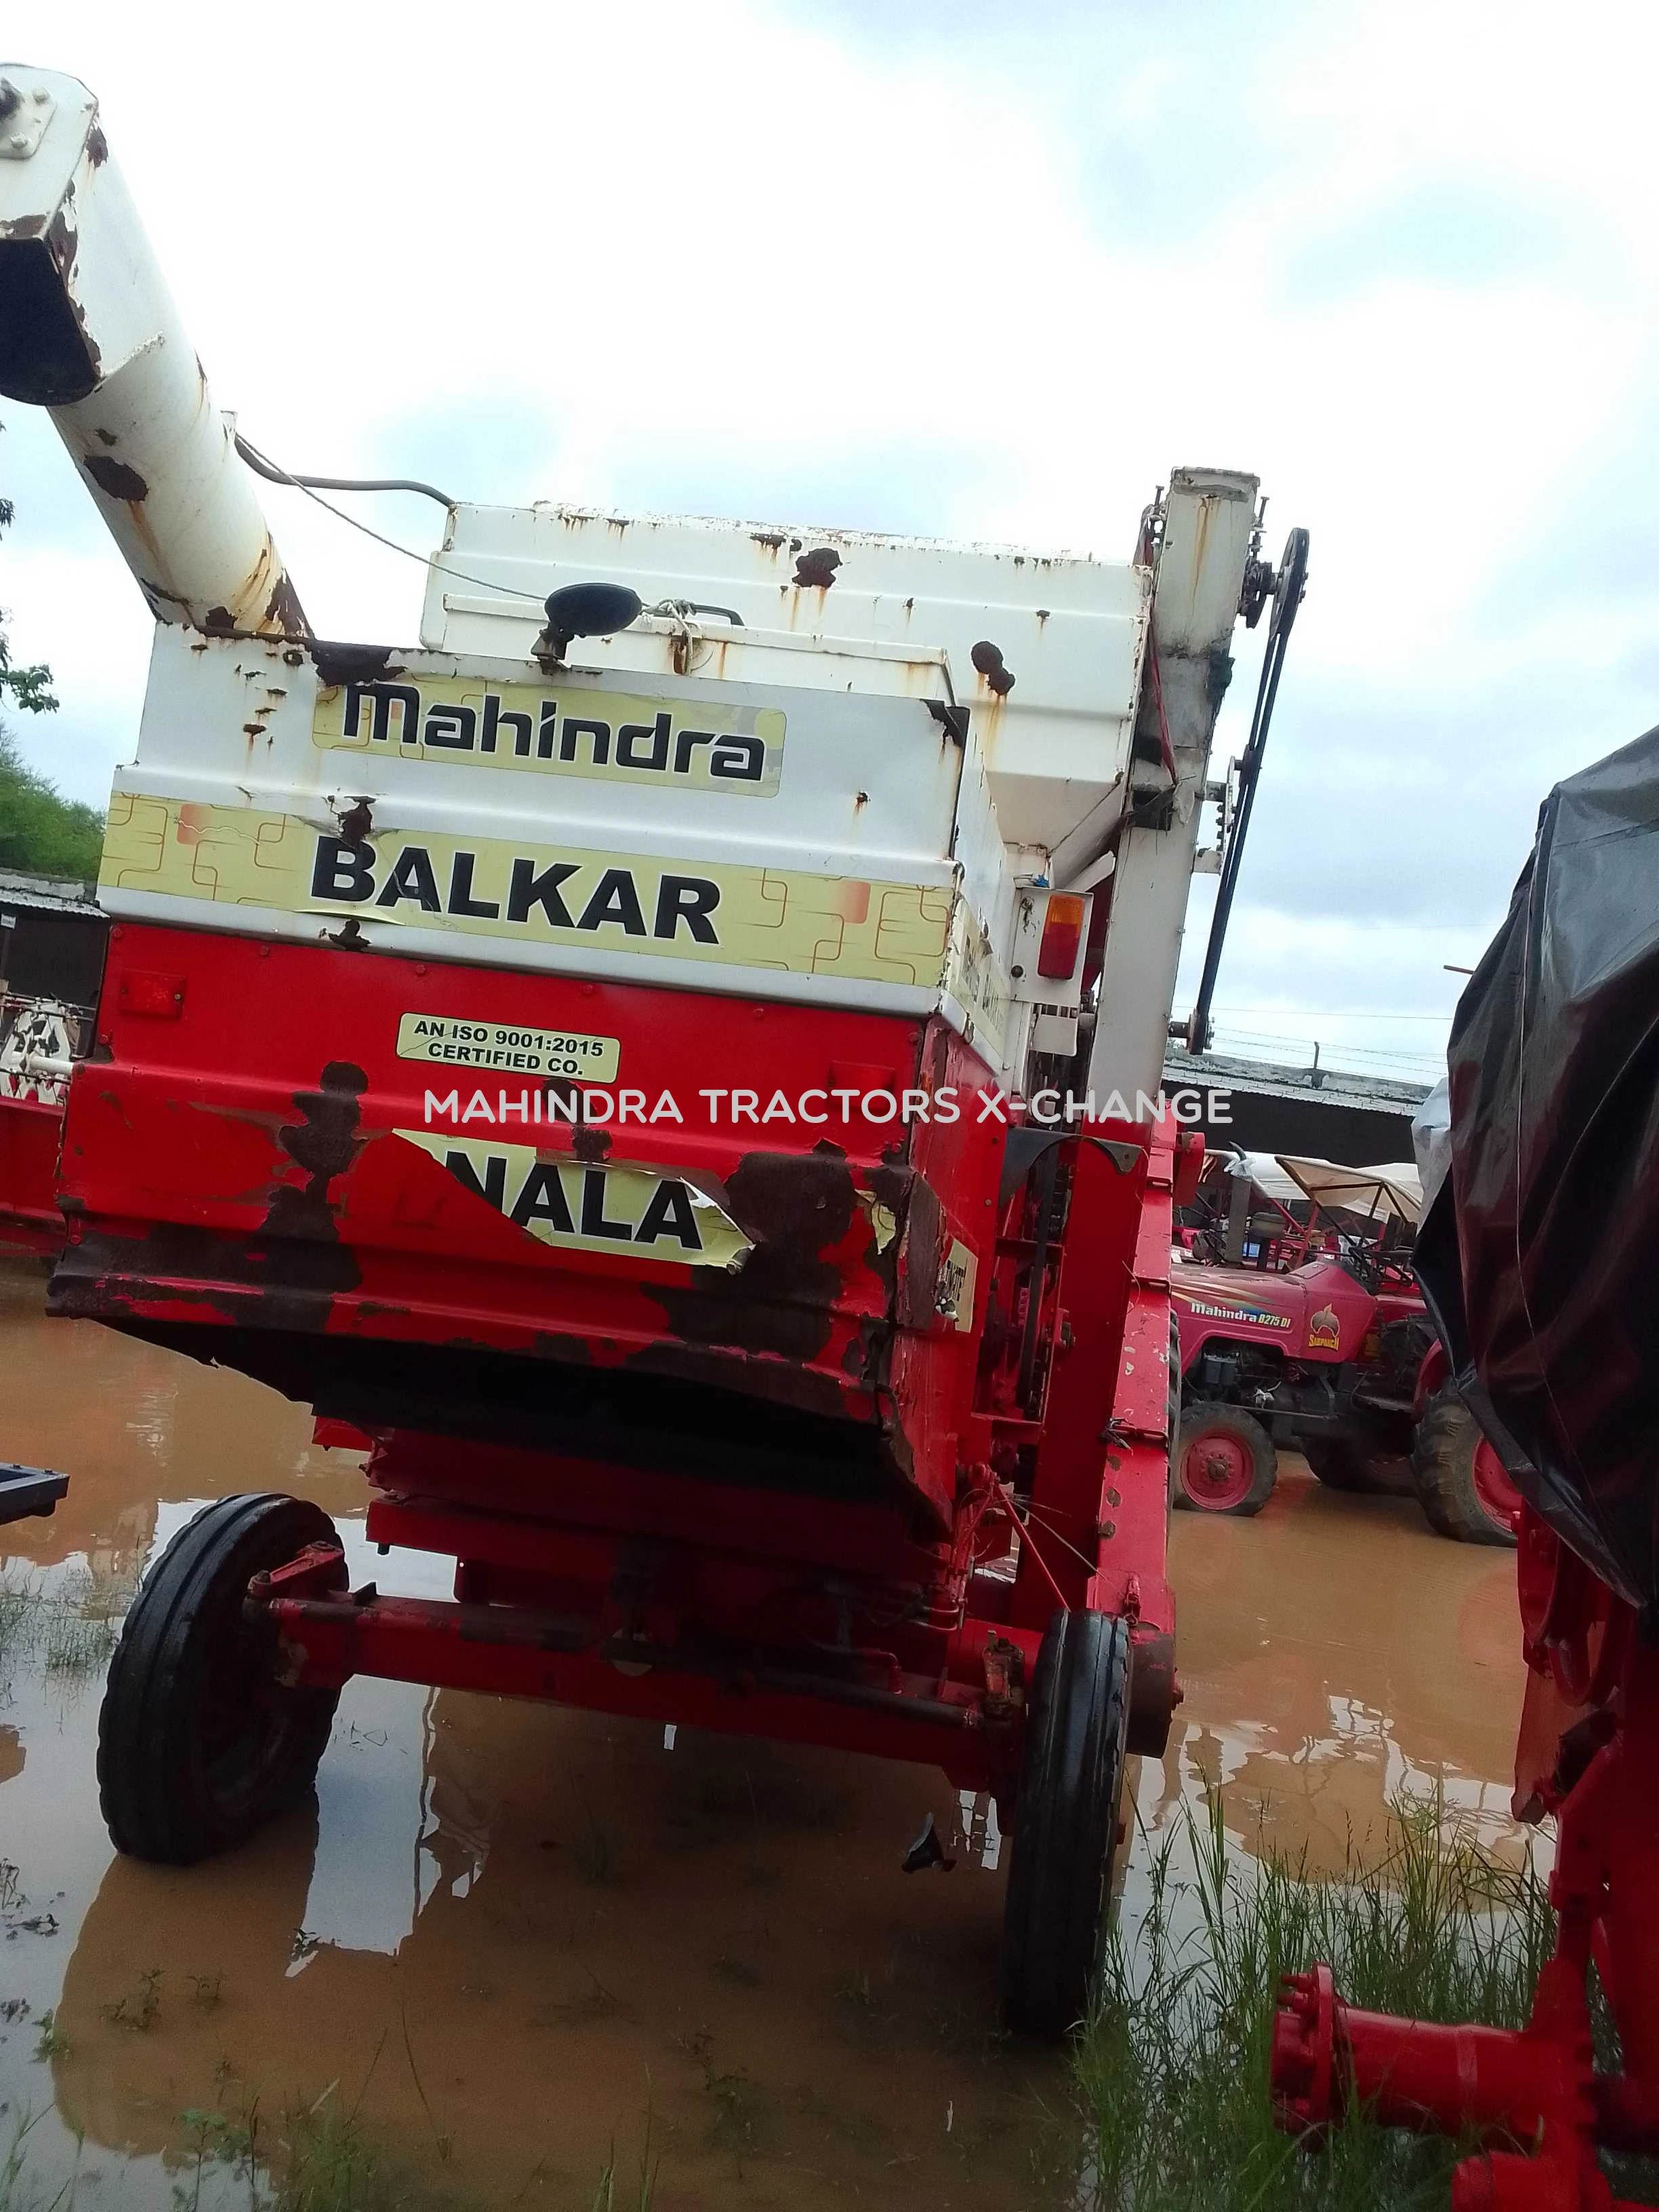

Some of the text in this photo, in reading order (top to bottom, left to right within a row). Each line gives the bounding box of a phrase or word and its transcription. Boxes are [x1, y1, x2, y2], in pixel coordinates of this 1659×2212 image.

[310, 836, 722, 945] BALKAR
[413, 1020, 605, 1057] AN ISO 9001:2015
[428, 1042, 583, 1076] CERTIFIED CO.
